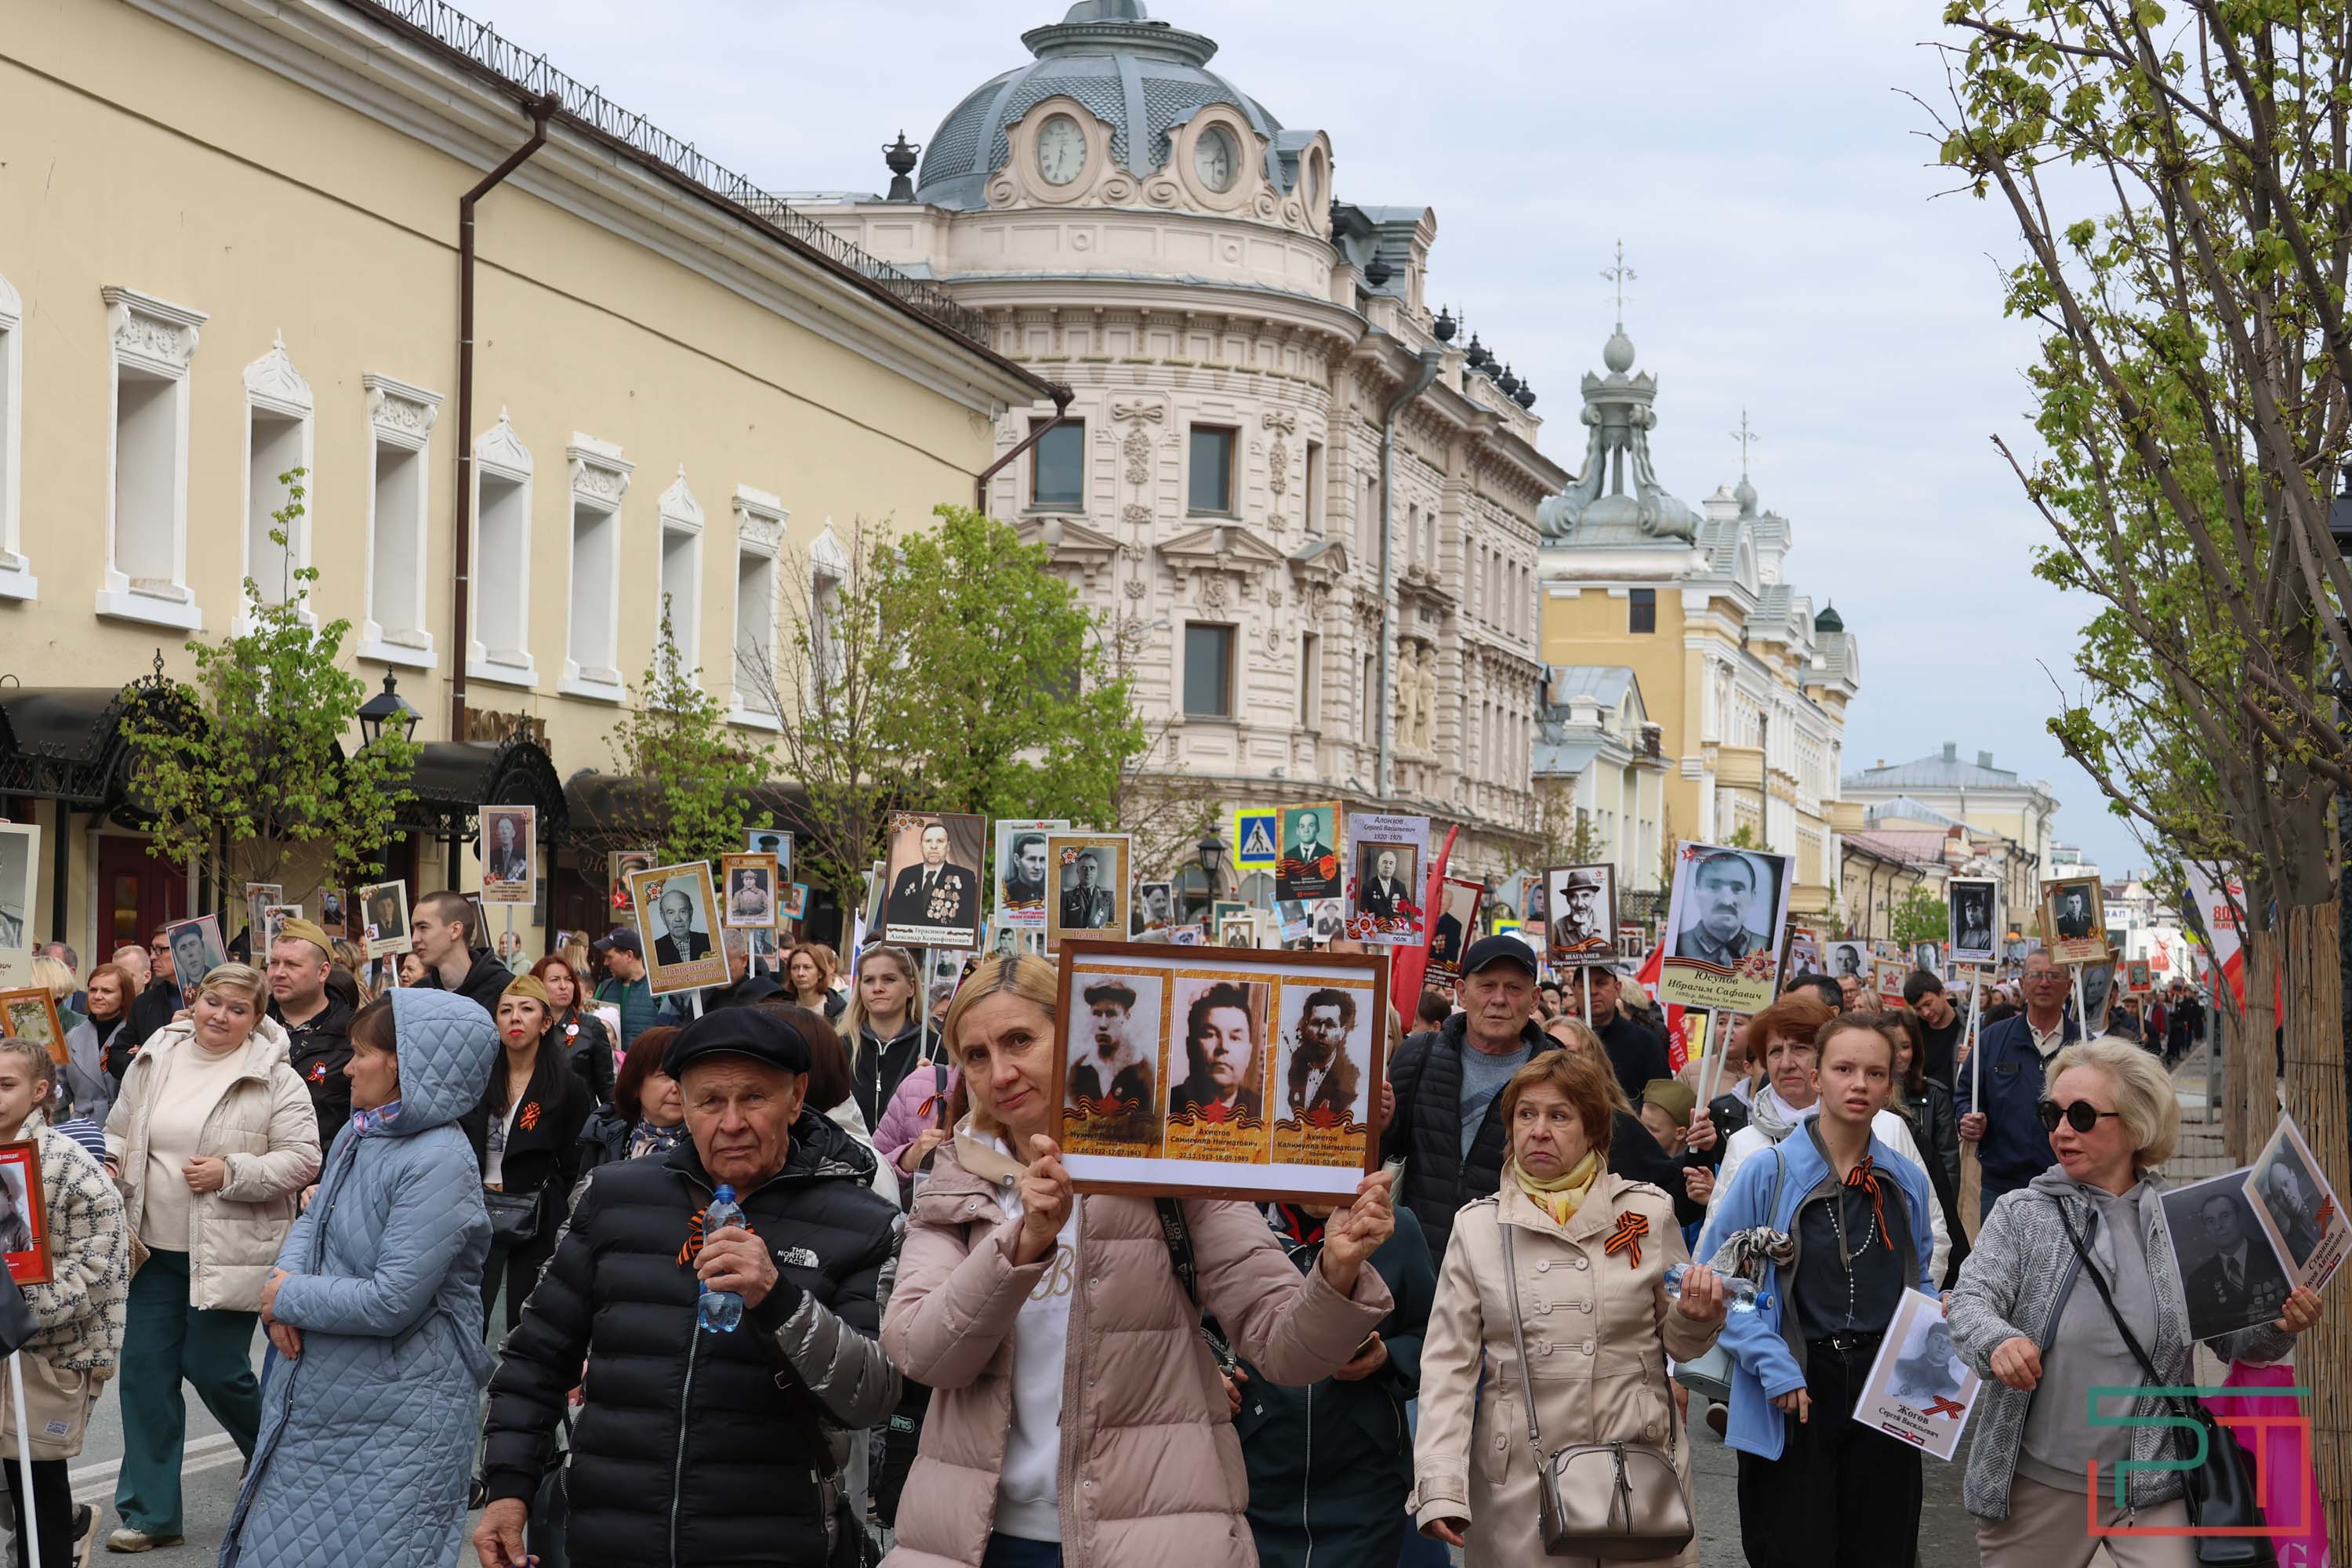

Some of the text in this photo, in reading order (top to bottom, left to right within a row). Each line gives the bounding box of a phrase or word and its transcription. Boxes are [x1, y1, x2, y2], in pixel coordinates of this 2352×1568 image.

[1374, 816, 1404, 825] Алонзов
[662, 962, 715, 977] Лаврентьев
[1694, 971, 1739, 985] Юсупов
[1668, 979, 1762, 1000] Ибрагим Сафавич
[777, 1250, 805, 1260] NORTH
[783, 1257, 804, 1266] FACE
[1897, 1404, 1929, 1425] Жогов
